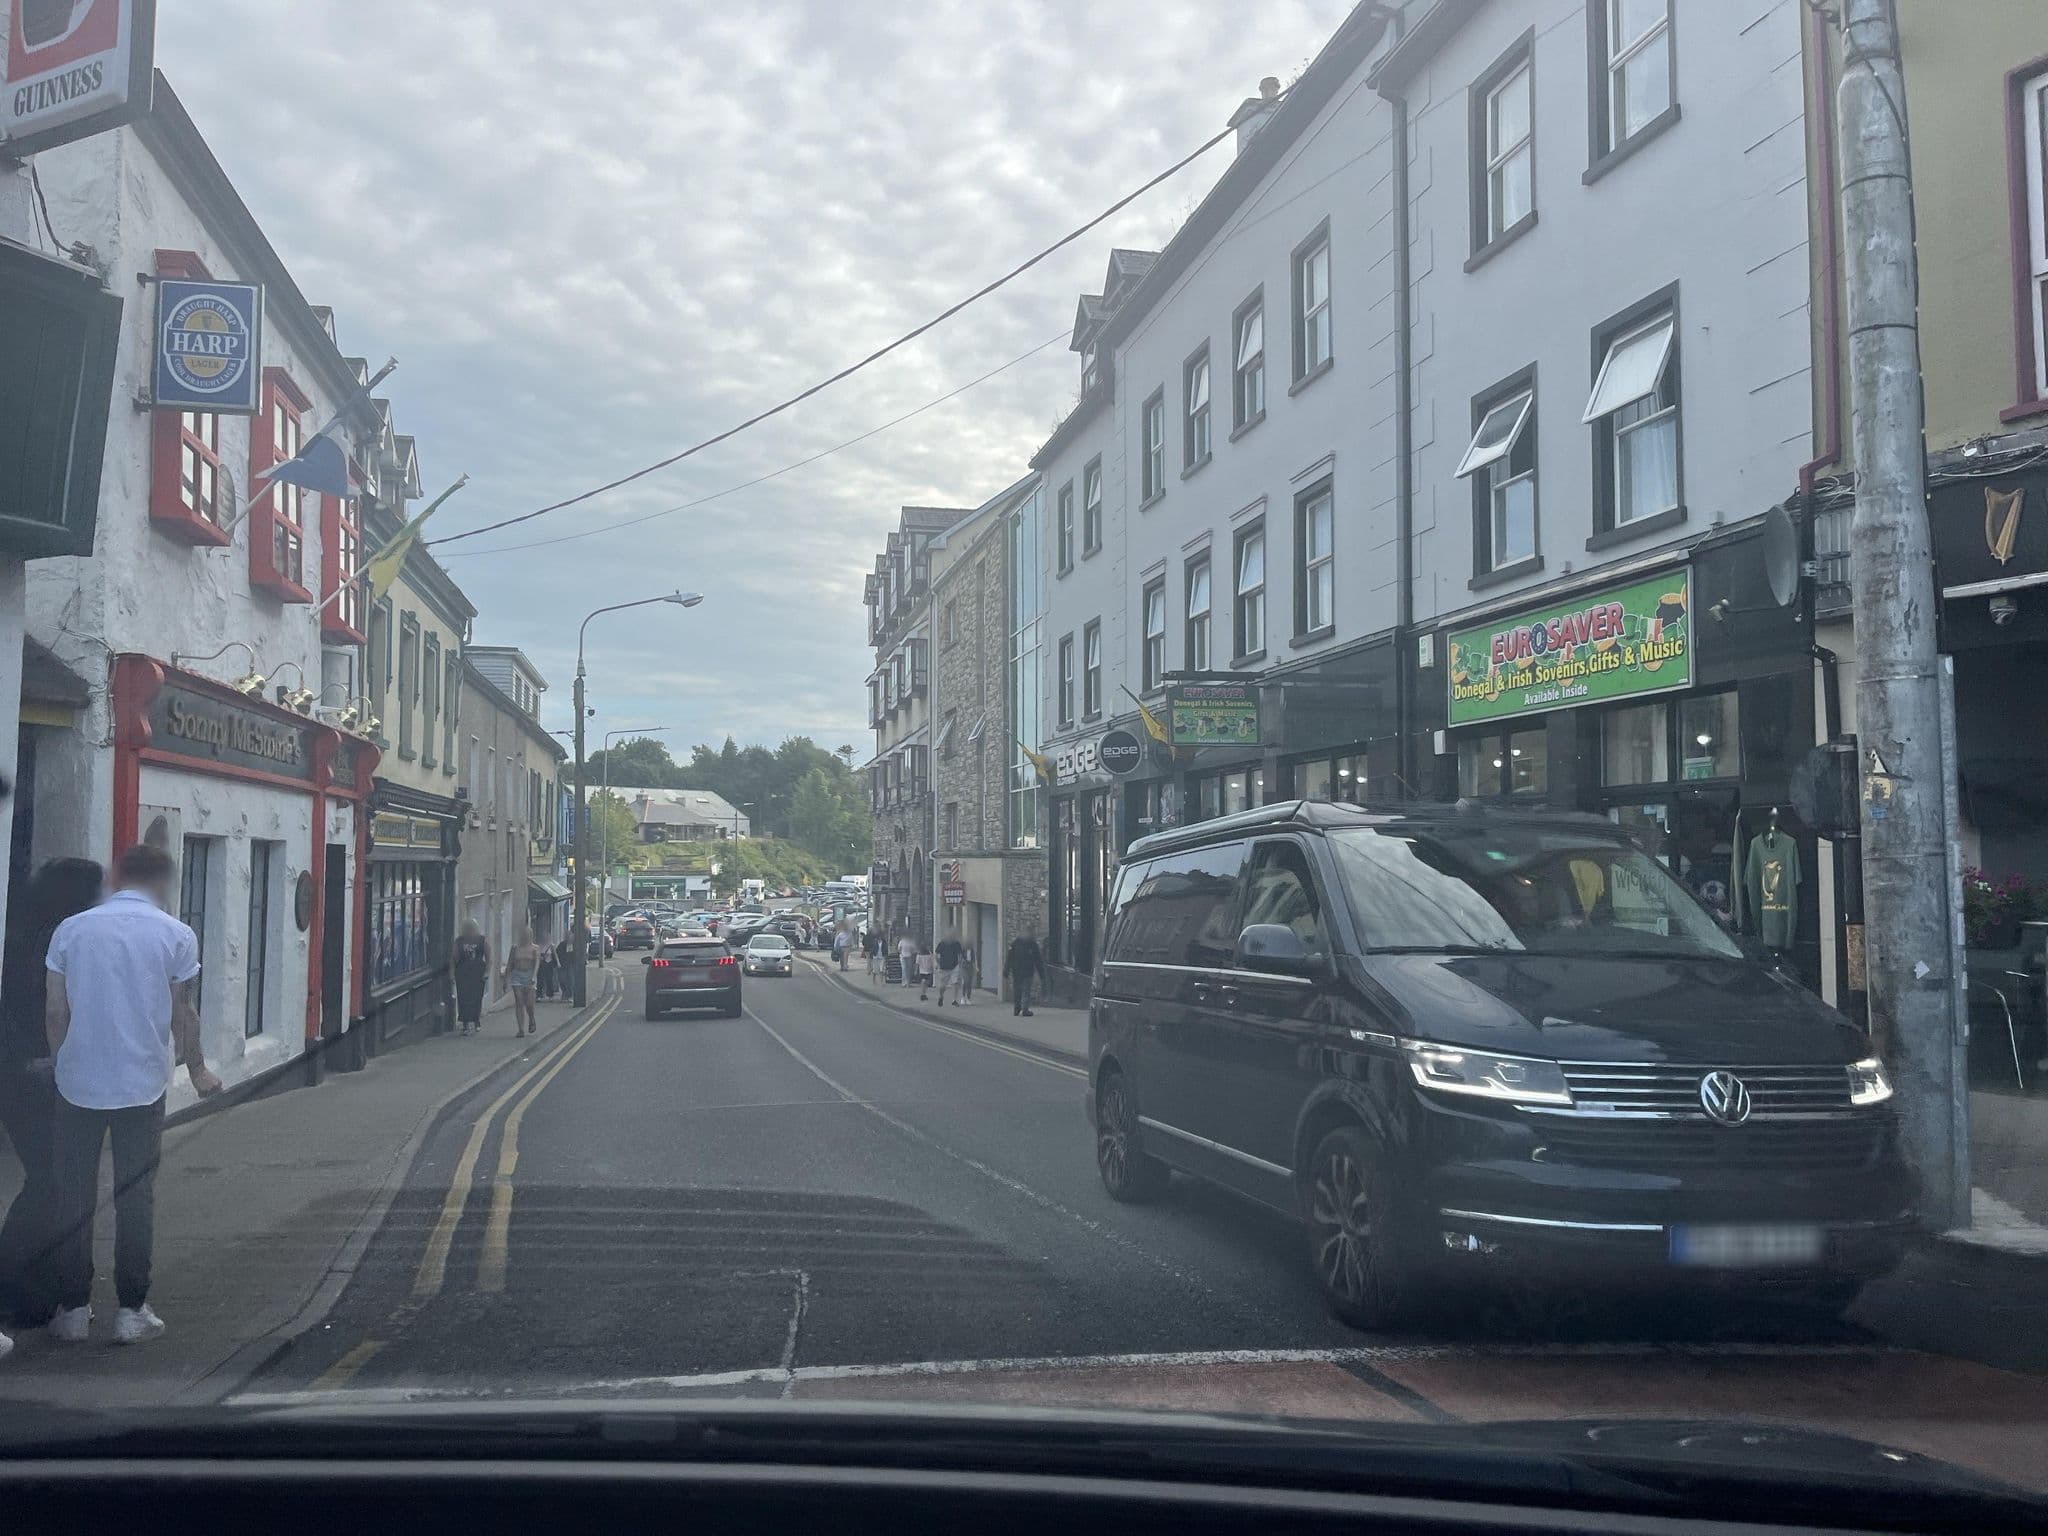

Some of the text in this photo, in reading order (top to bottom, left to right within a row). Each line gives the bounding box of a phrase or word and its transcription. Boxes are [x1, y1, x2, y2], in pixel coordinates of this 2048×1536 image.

[14, 60, 103, 117] GUINNESS
[177, 300, 237, 326] DRAUGHT HARP
[172, 332, 239, 355] HARP
[191, 359, 219, 369] LAGER
[1490, 601, 1626, 665] EUROSAVER
[1454, 677, 1494, 700] Donegal
[1496, 675, 1505, 691] &
[1508, 668, 1533, 689] Irish
[1624, 646, 1636, 666] &
[1640, 637, 1684, 662] Music
[1183, 687, 1245, 698] EUROSAVER
[1524, 684, 1588, 705] Available Inside
[168, 700, 230, 755] Sonny
